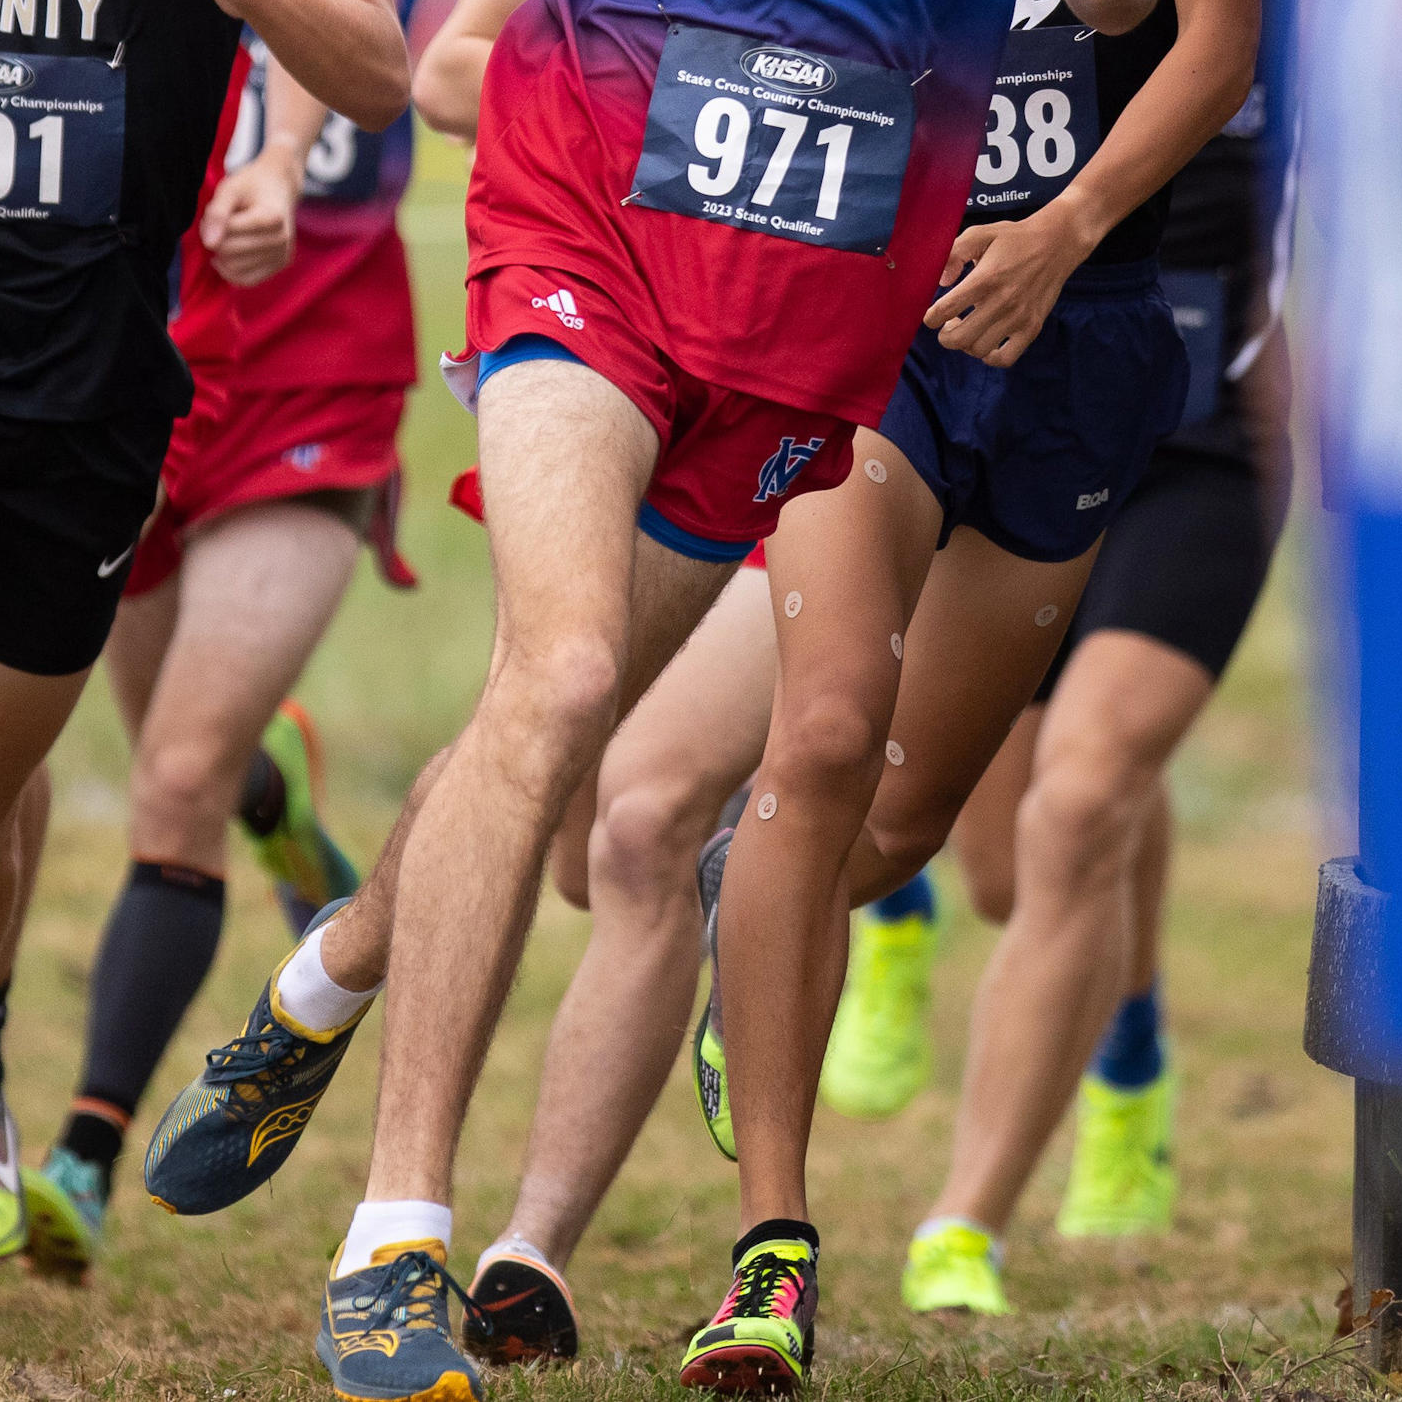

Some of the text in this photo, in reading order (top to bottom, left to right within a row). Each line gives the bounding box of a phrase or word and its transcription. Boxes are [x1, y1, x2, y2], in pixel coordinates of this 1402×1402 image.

[751, 54, 825, 86] KHSAA
[996, 70, 1073, 86] ampionships
[10, 97, 103, 114] Championships
[677, 70, 895, 127] State Cross Country Championships
[975, 88, 1076, 185] 38
[687, 97, 854, 221] 971
[976, 190, 1031, 206] Qualifier
[702, 201, 825, 237] 2023 State Qualifier
